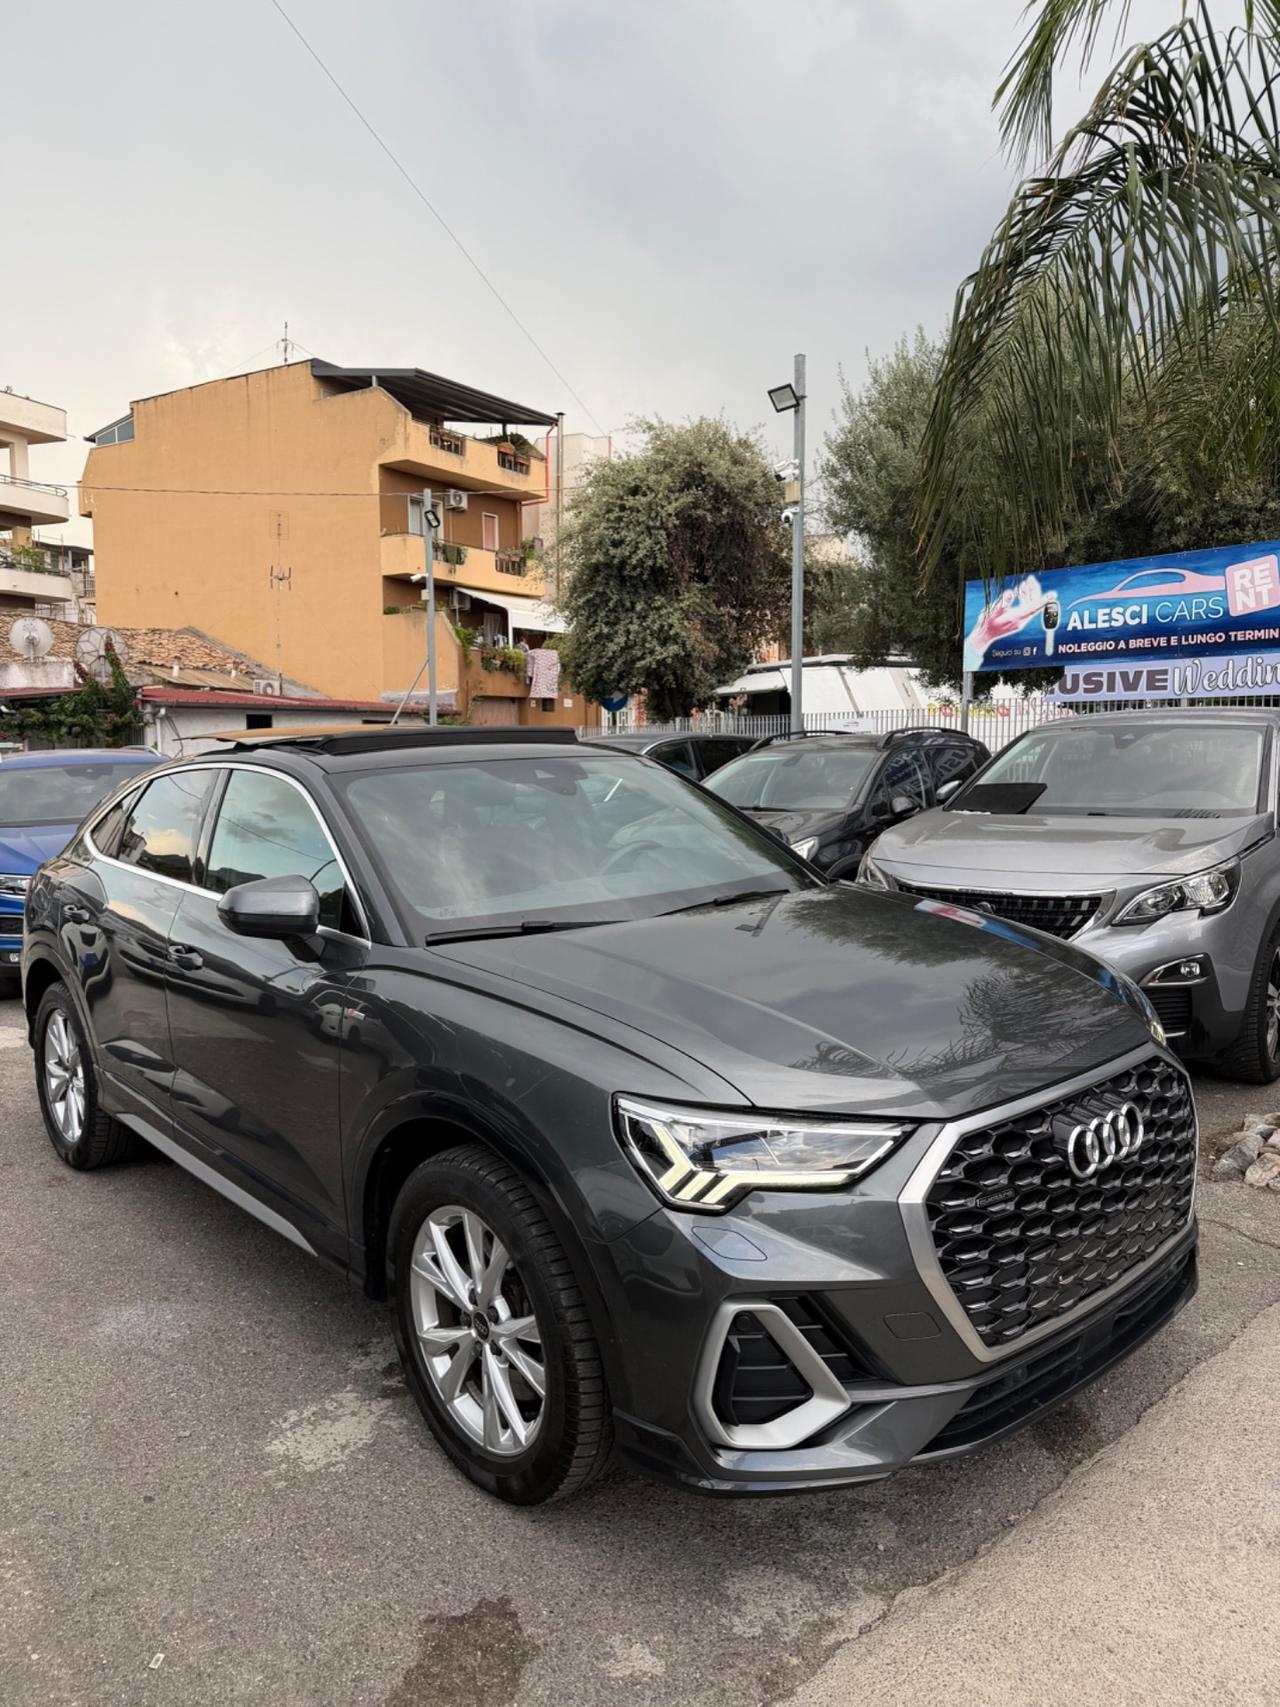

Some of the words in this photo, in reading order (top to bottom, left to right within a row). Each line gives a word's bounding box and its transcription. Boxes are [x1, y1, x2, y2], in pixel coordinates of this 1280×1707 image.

[1066, 603, 1148, 631] ALESCI
[1155, 596, 1224, 623] CARS
[1058, 640, 1115, 654] NOLEGGIO
[1117, 639, 1126, 650] A
[1128, 636, 1167, 649] BREVE
[1170, 635, 1178, 646] E
[1181, 632, 1226, 645] LUNGO
